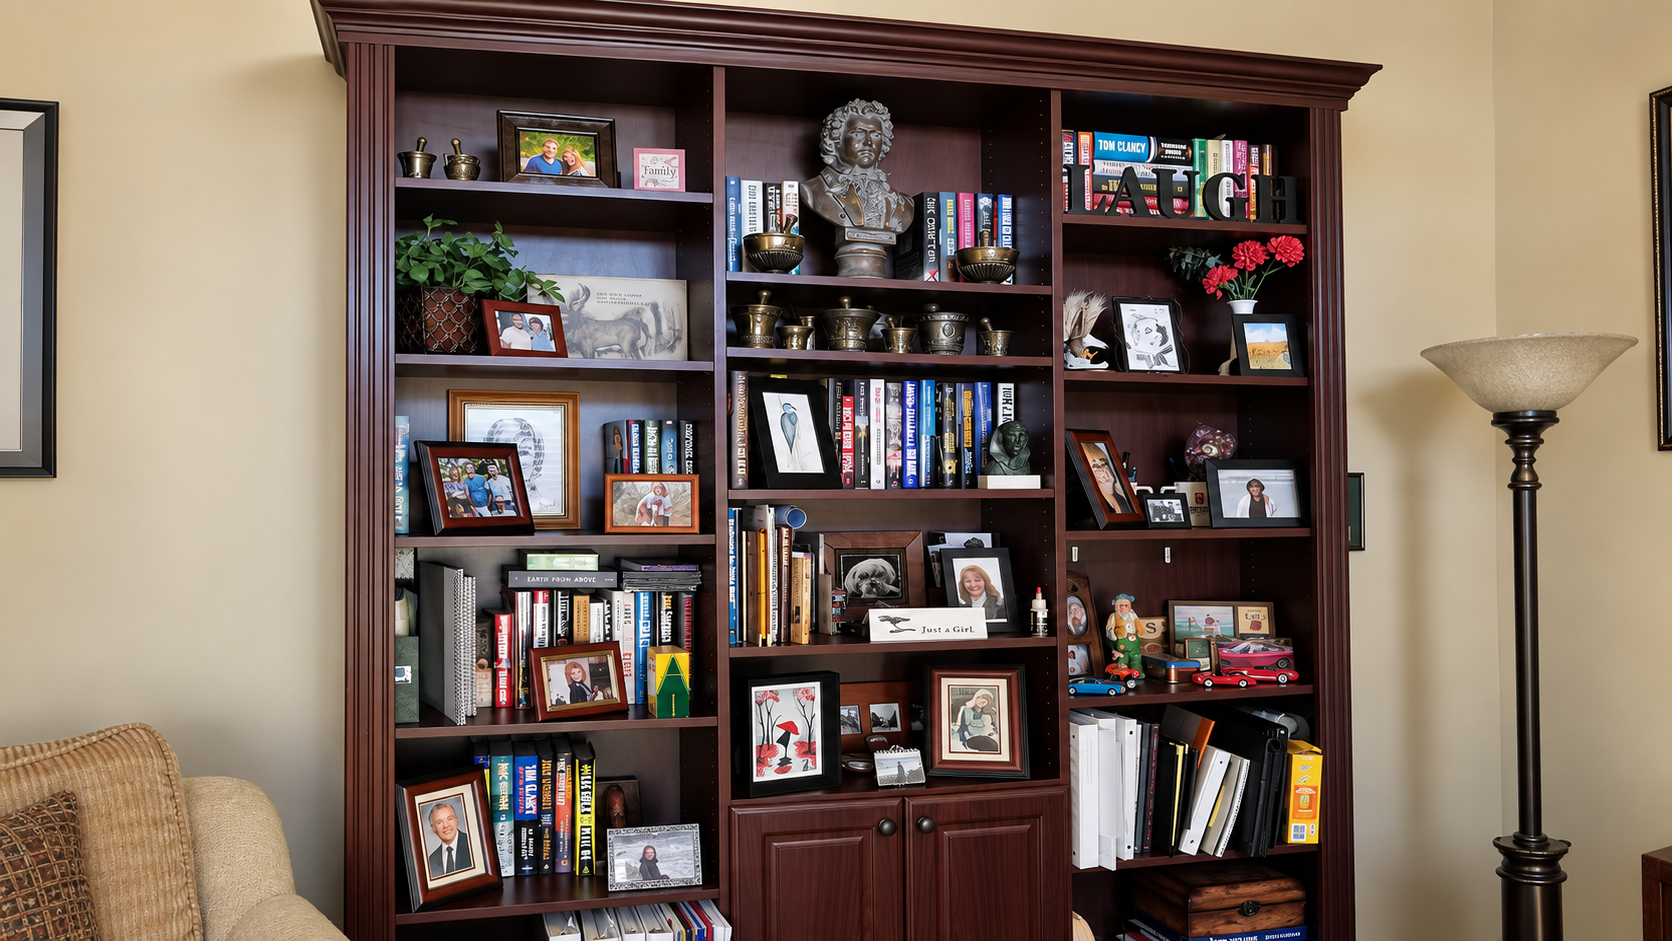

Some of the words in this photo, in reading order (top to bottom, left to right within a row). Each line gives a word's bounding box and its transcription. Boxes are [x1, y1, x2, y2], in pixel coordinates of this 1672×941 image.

[1098, 139, 1115, 151] TOM
[1117, 140, 1147, 153] CLANCY
[644, 165, 677, 179] Family
[1062, 163, 1303, 224] LAUGH
[921, 626, 942, 634] Just
